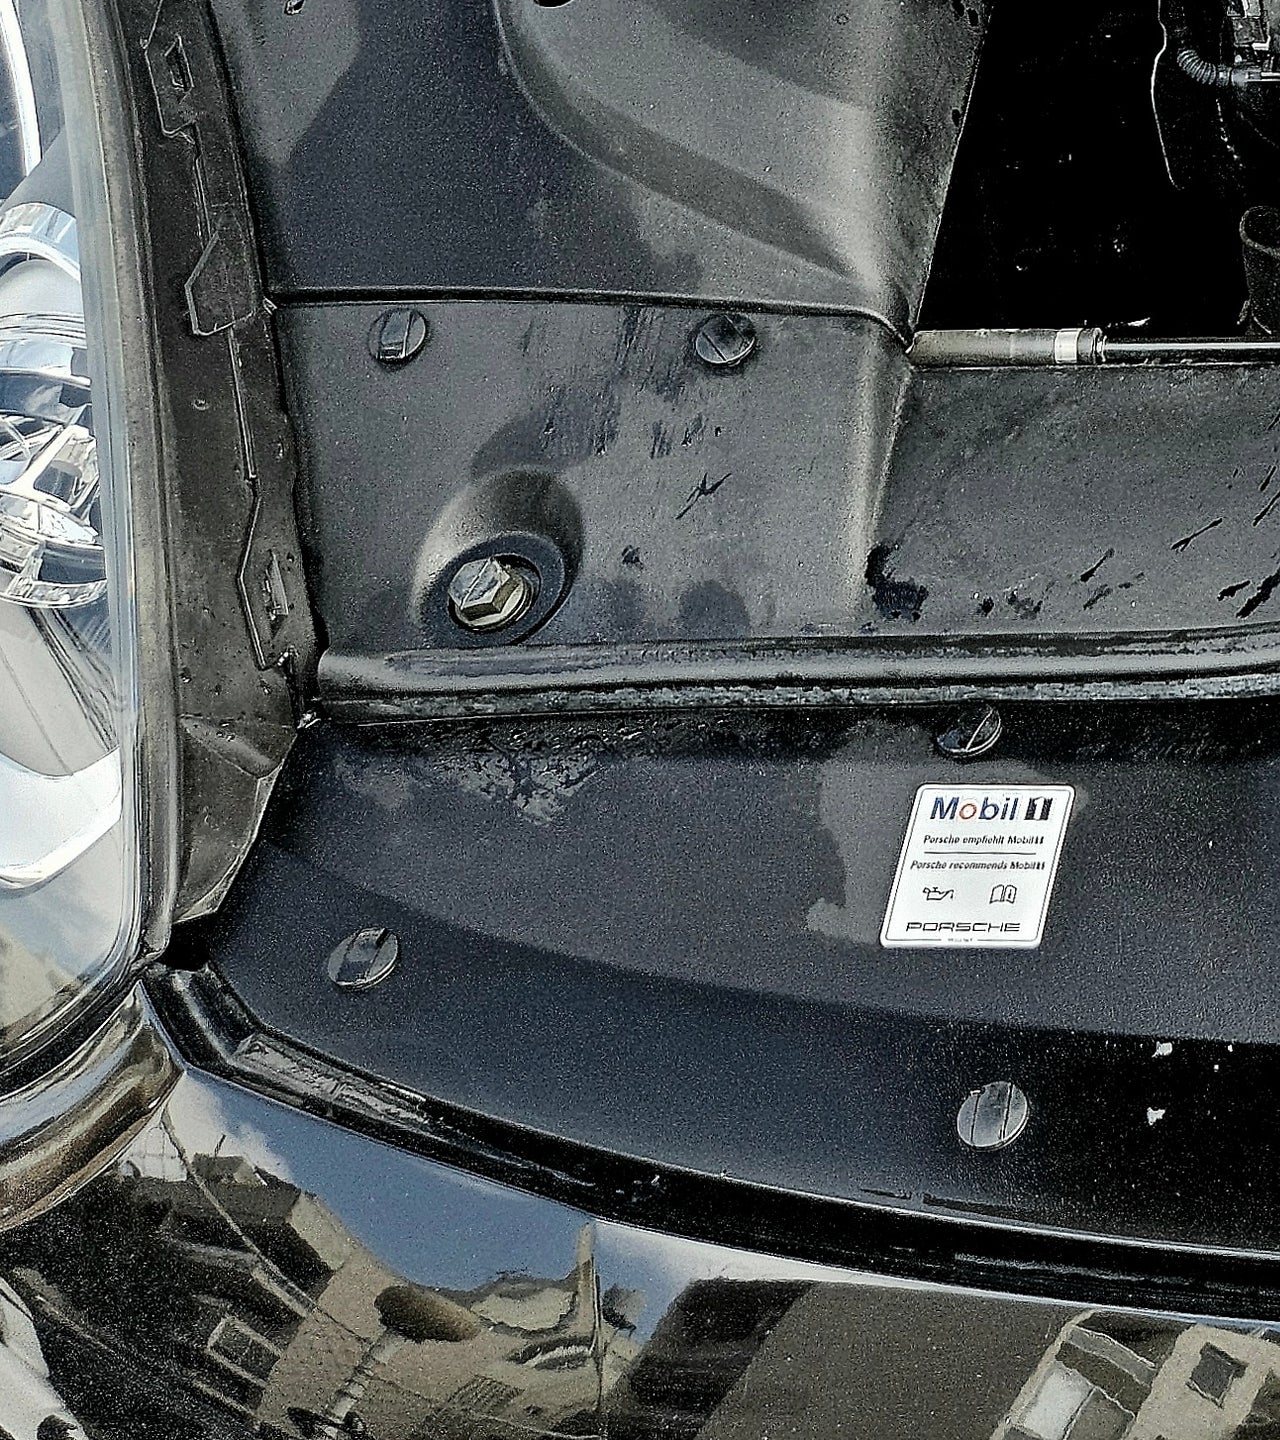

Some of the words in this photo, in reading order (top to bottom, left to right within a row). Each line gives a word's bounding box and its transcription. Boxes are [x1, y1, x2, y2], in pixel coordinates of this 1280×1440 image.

[929, 796, 1019, 820] Mobil
[923, 835, 960, 845] Porsche
[962, 835, 1005, 847] empfiehlt
[910, 860, 947, 870] Porsche
[948, 861, 1008, 870] recommends
[905, 922, 1021, 933] PORSCHE
